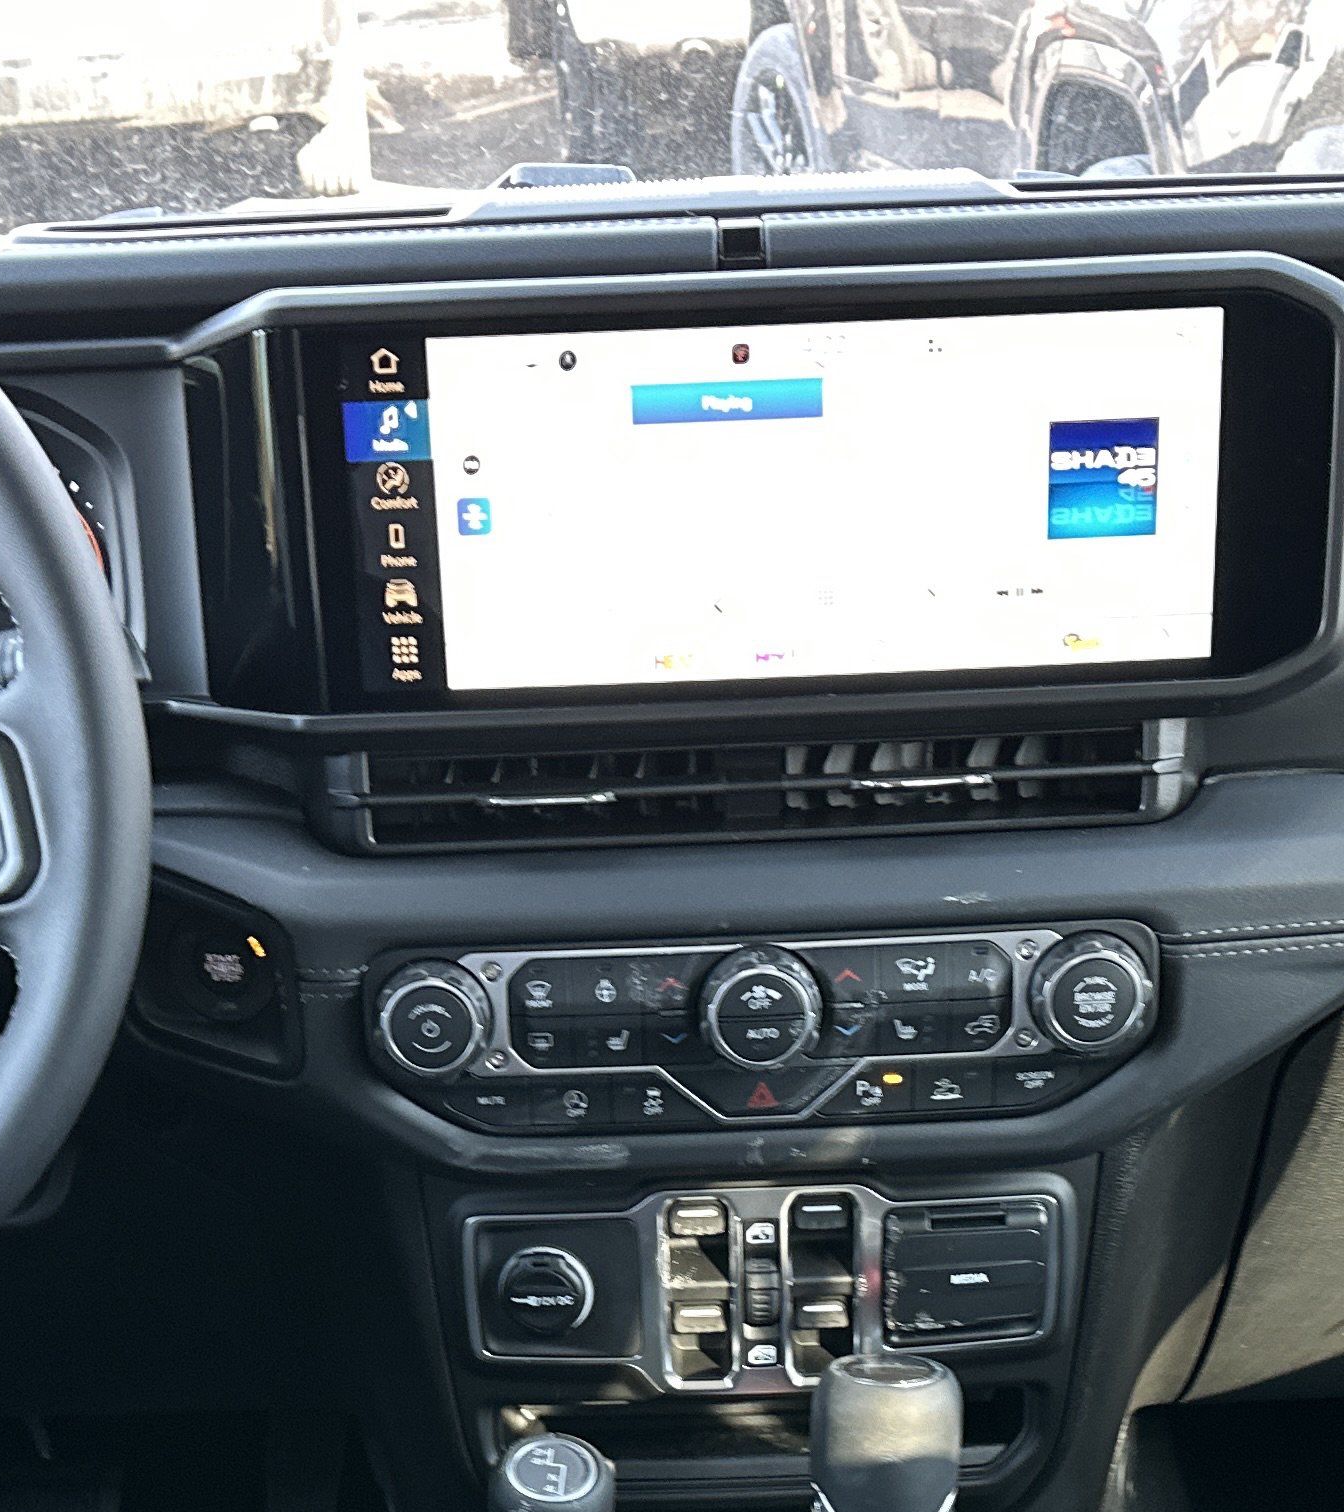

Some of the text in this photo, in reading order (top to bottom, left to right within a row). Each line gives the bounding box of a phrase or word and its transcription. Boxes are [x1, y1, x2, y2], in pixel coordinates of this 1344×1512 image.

[368, 380, 405, 393] Home
[1050, 446, 1156, 470] SHADE
[370, 497, 420, 510] Comfort
[380, 554, 418, 568] Phone
[382, 610, 423, 624] Vehicle
[392, 667, 423, 682] Apps
[968, 968, 998, 984] A/C
[746, 1027, 780, 1040] AUTO
[950, 1273, 989, 1284] MEDIA
